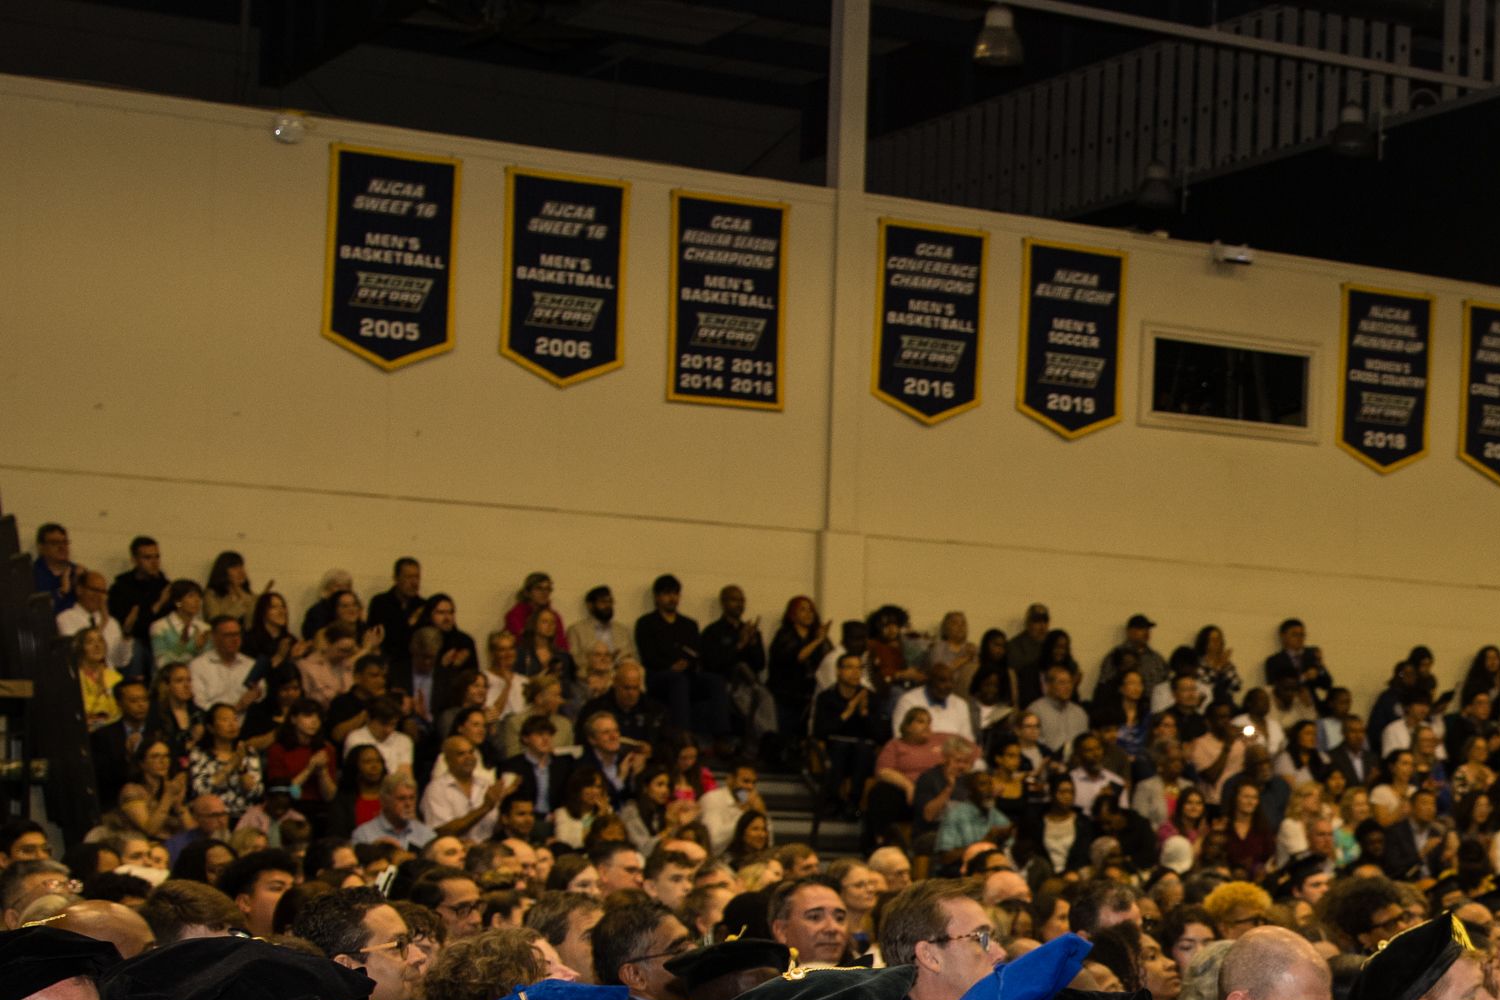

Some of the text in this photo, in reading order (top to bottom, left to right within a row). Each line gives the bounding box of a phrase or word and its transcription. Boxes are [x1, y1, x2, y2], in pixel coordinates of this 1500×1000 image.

[369, 180, 425, 197] NJCAA
[354, 196, 437, 217] SWEET 16
[541, 201, 595, 219] NJCAA
[528, 219, 607, 239] SWEET 16
[366, 233, 420, 250] MEN'S
[341, 246, 444, 269] BASKETBALL
[540, 254, 591, 271] MEN'S
[684, 248, 775, 269] CHAMPIONS
[888, 257, 977, 278] CONFERENCE
[517, 266, 614, 289] BASKETBALL
[704, 275, 753, 292] MEN'S
[890, 274, 975, 294] CHAMPIONS
[681, 288, 774, 309] BASKETBALL
[909, 299, 955, 316] MEN'S
[361, 318, 420, 341] 2005
[887, 311, 975, 333] BASKETBALL
[1052, 318, 1096, 334] MEN'S
[536, 337, 592, 359] 2006
[1049, 331, 1100, 348] SOCCER
[681, 354, 773, 376] 2012 2013
[680, 373, 723, 390] 2014
[903, 377, 954, 398] 2016
[1047, 394, 1095, 414] 2019
